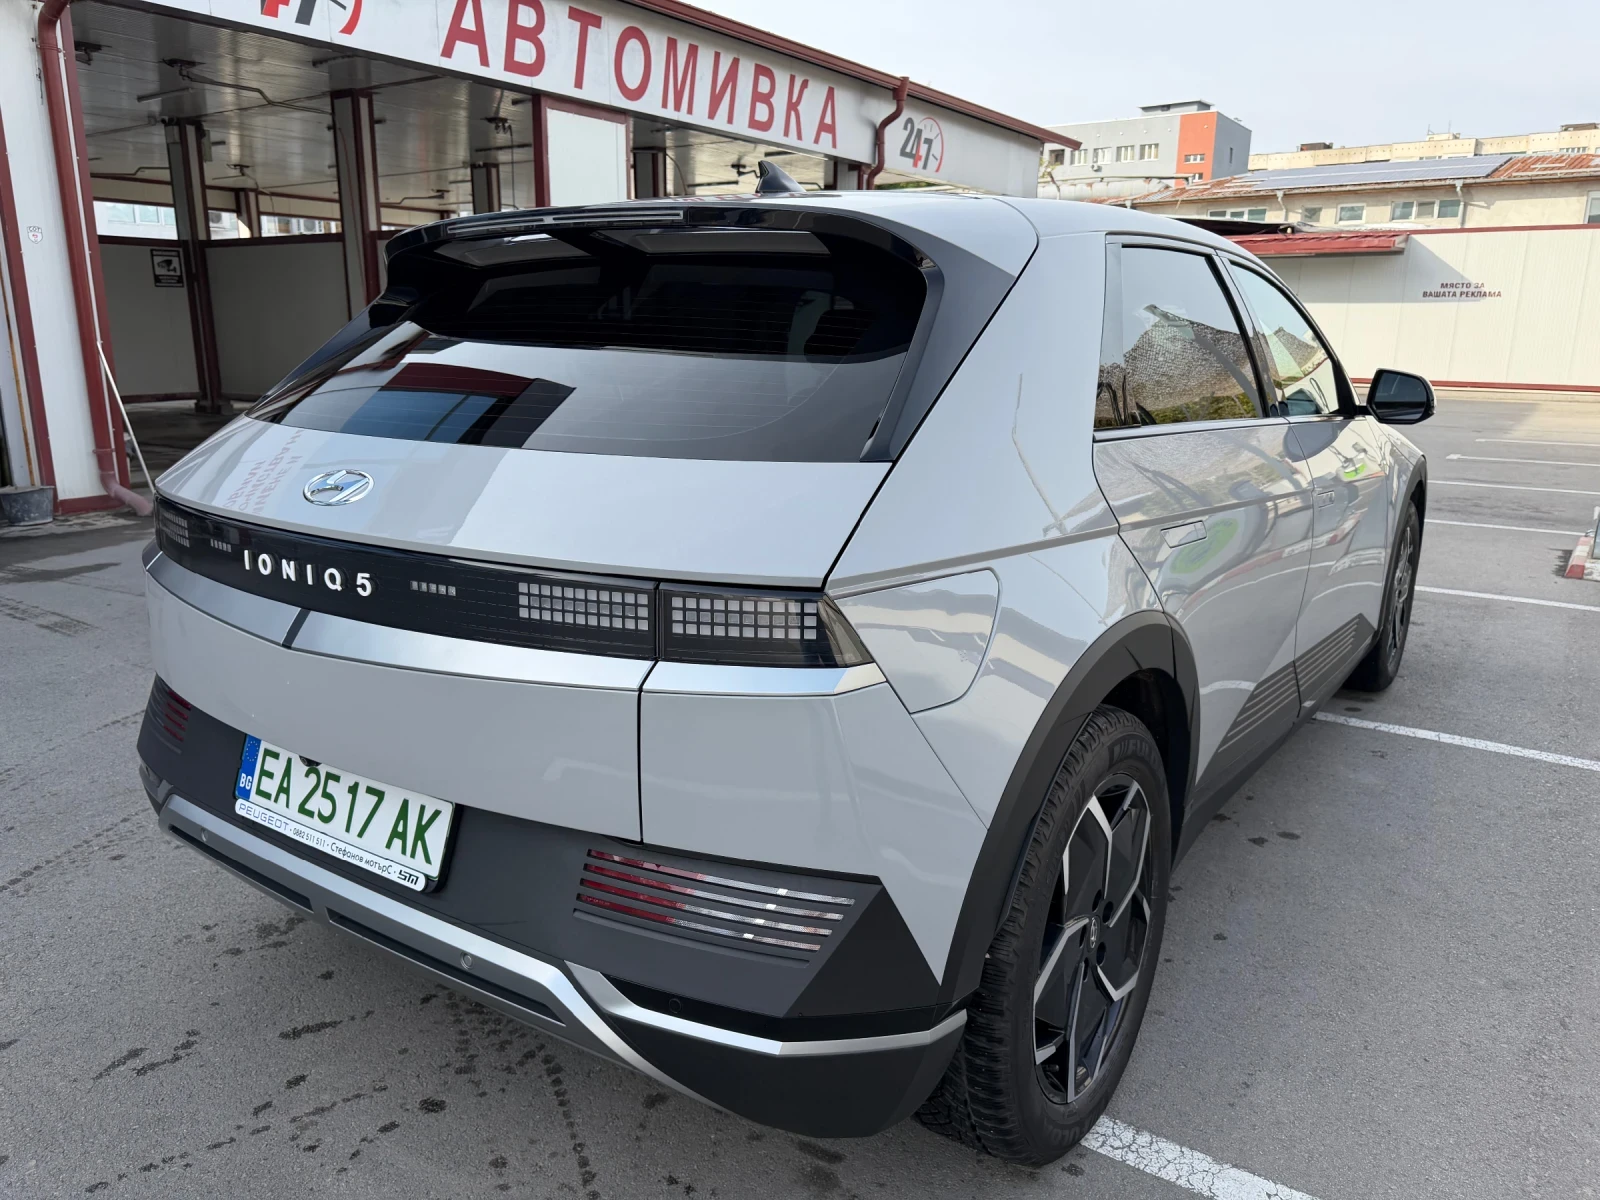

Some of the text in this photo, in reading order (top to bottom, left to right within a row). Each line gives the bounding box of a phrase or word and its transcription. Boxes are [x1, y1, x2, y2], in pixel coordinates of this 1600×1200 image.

[440, 0, 837, 149] АВТОМИВКА
[1422, 290, 1502, 298] ВАШАТА РЕКЛАМА
[243, 550, 374, 597] IONIQ 5
[239, 772, 252, 791] BG
[255, 748, 442, 866] EA 2517 AK
[238, 802, 289, 831] PEUGEOT
[305, 833, 315, 844] 511
[316, 837, 326, 848] 511
[330, 842, 364, 864] Стефанов
